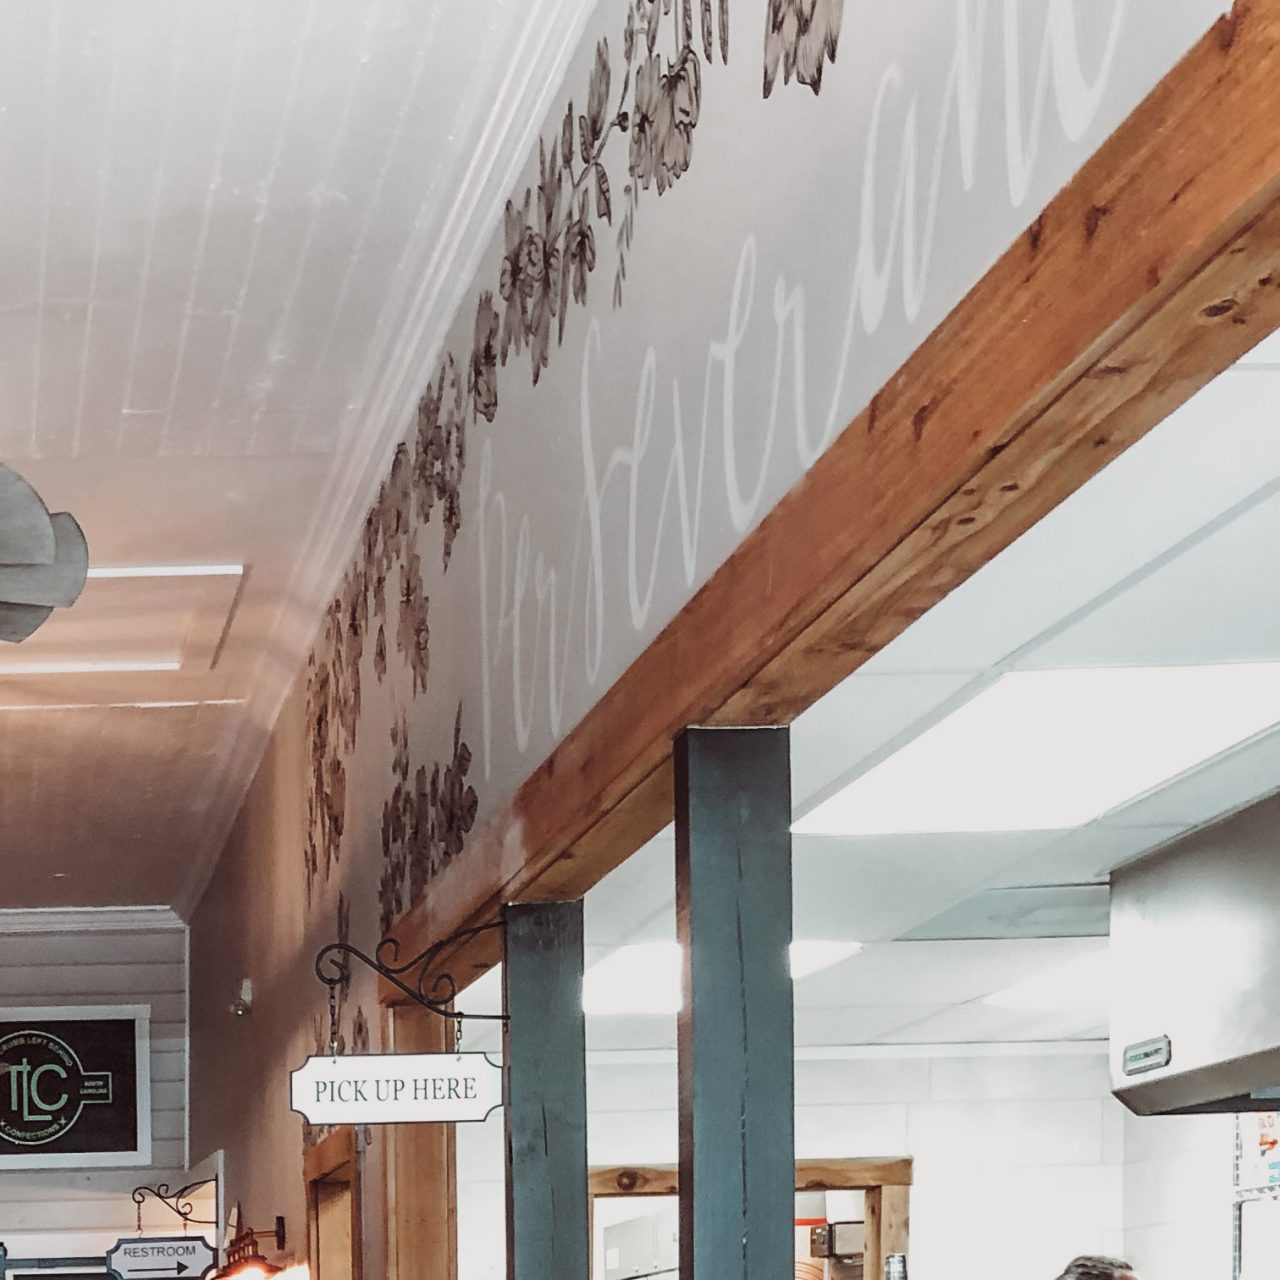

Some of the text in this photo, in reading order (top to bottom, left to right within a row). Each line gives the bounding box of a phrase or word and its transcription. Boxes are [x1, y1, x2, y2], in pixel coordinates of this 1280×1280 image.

[315, 1077, 477, 1102] PICK UP HERE
[4, 1124, 61, 1140] CONFECTIONS
[123, 1246, 196, 1258] RESTROOM
